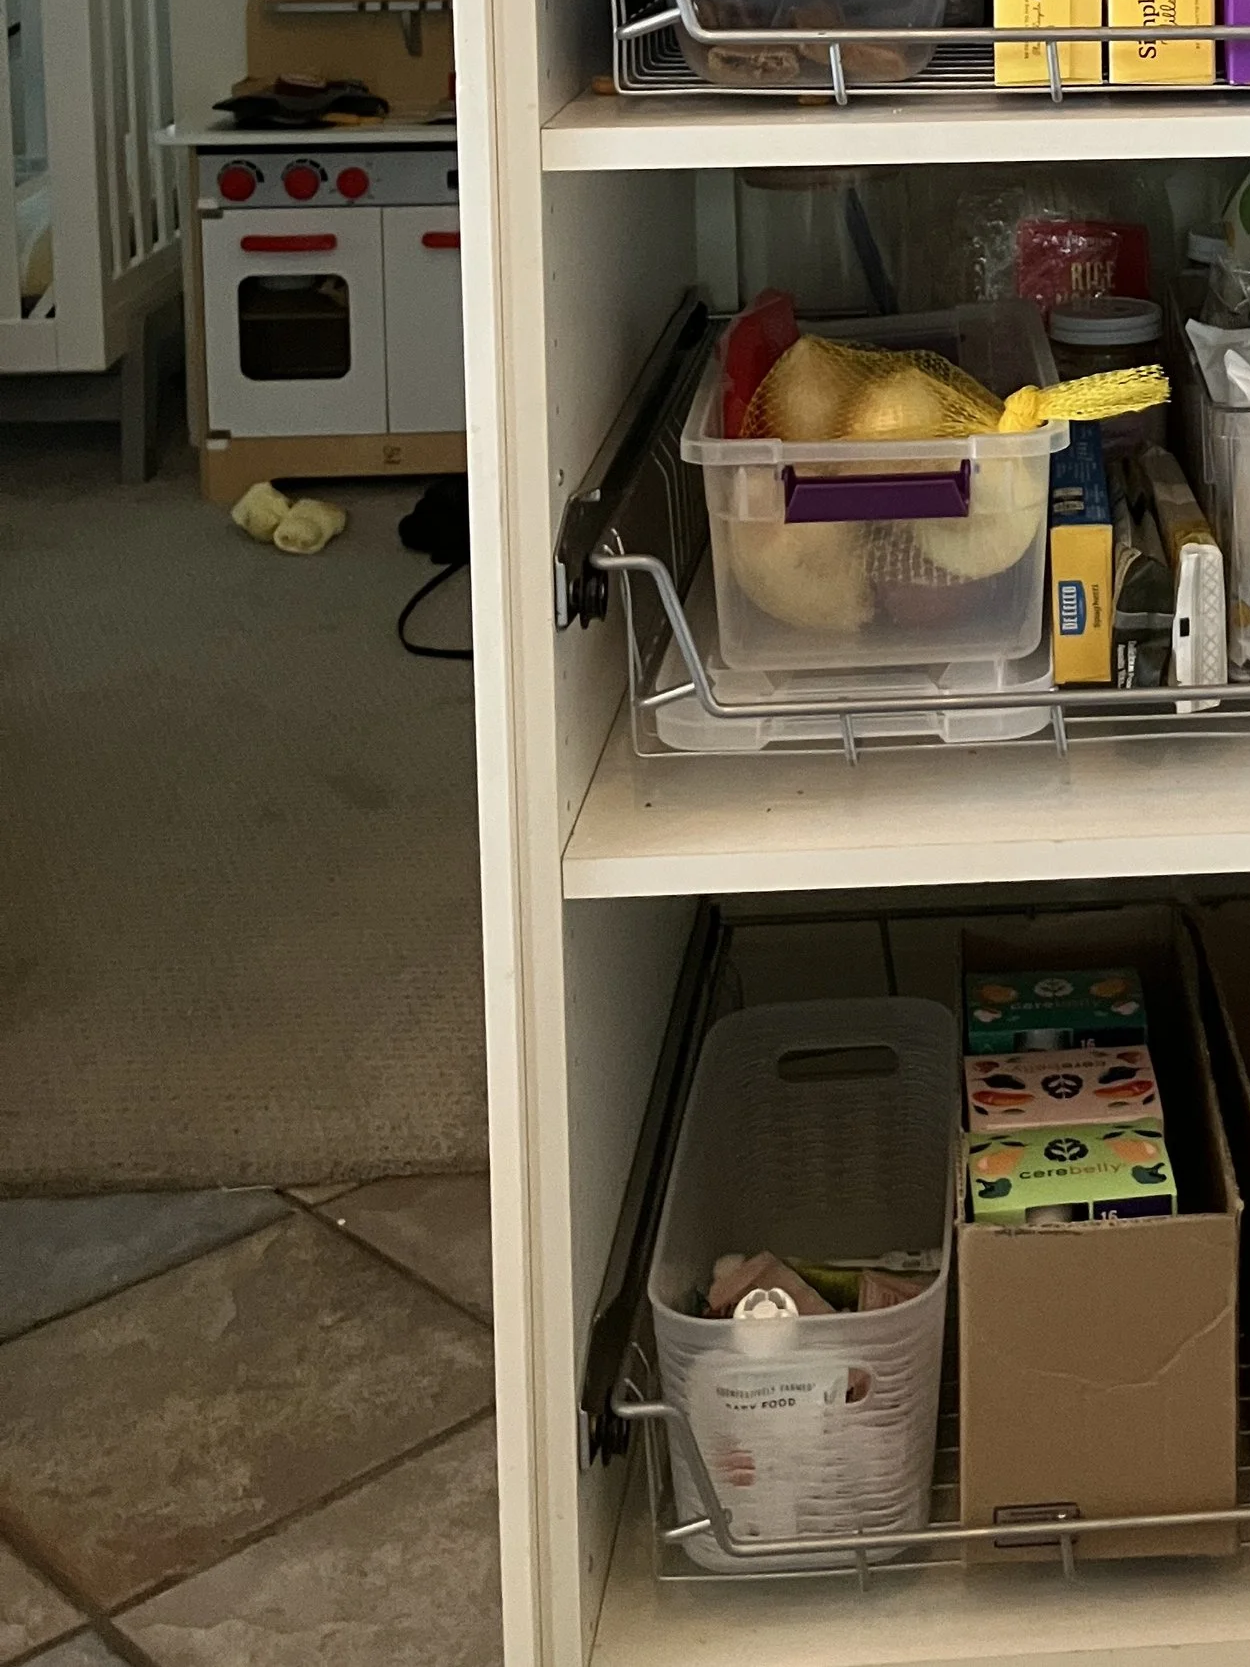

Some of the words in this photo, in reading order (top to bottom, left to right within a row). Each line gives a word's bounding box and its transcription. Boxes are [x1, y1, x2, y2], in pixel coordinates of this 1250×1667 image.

[1071, 261, 1115, 291] RICE
[1092, 584, 1103, 629] Spaghetti
[1019, 1162, 1121, 1180] cerebelly
[762, 1398, 796, 1409] FOOD
